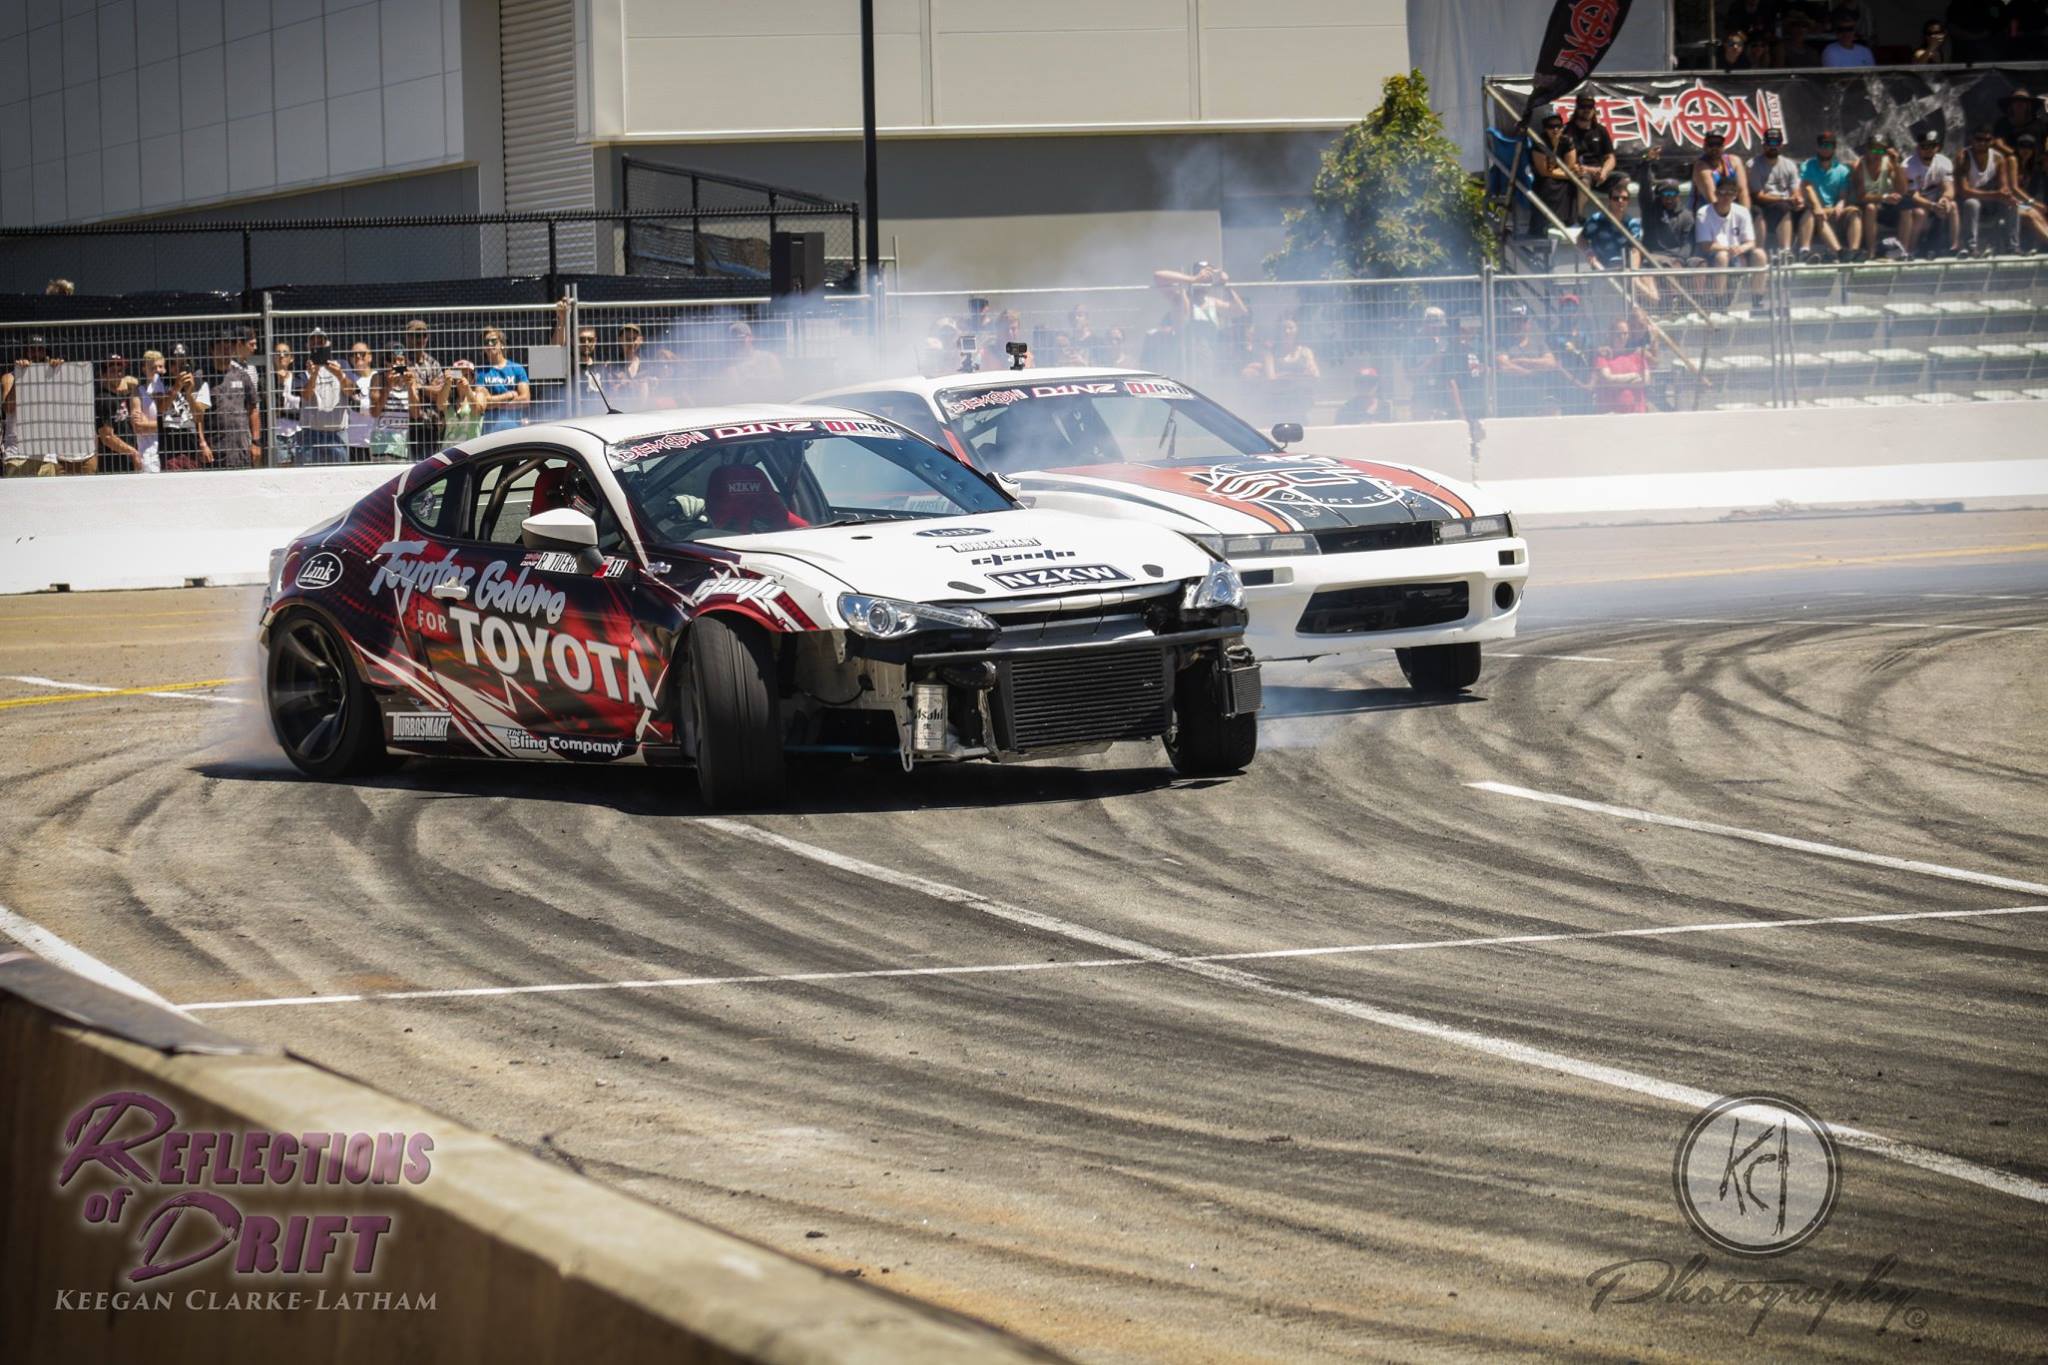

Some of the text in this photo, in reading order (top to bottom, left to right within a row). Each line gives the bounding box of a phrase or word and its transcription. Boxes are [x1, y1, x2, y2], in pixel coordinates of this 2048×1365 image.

[1551, 79, 1771, 150] EMON
[1032, 383, 1117, 398] D1NZ
[619, 431, 709, 461] DEMON
[714, 420, 814, 439] D1NZ
[1280, 492, 1353, 505] DIFT
[301, 560, 335, 581] Link
[549, 554, 578, 573] TUERC
[997, 566, 1117, 588] NZKW
[475, 560, 566, 625] Galore
[417, 607, 658, 711] FOR TOYOTA
[386, 711, 452, 737] TURBOSMART
[914, 708, 944, 720] Asahi
[510, 736, 621, 756] Bling Company
